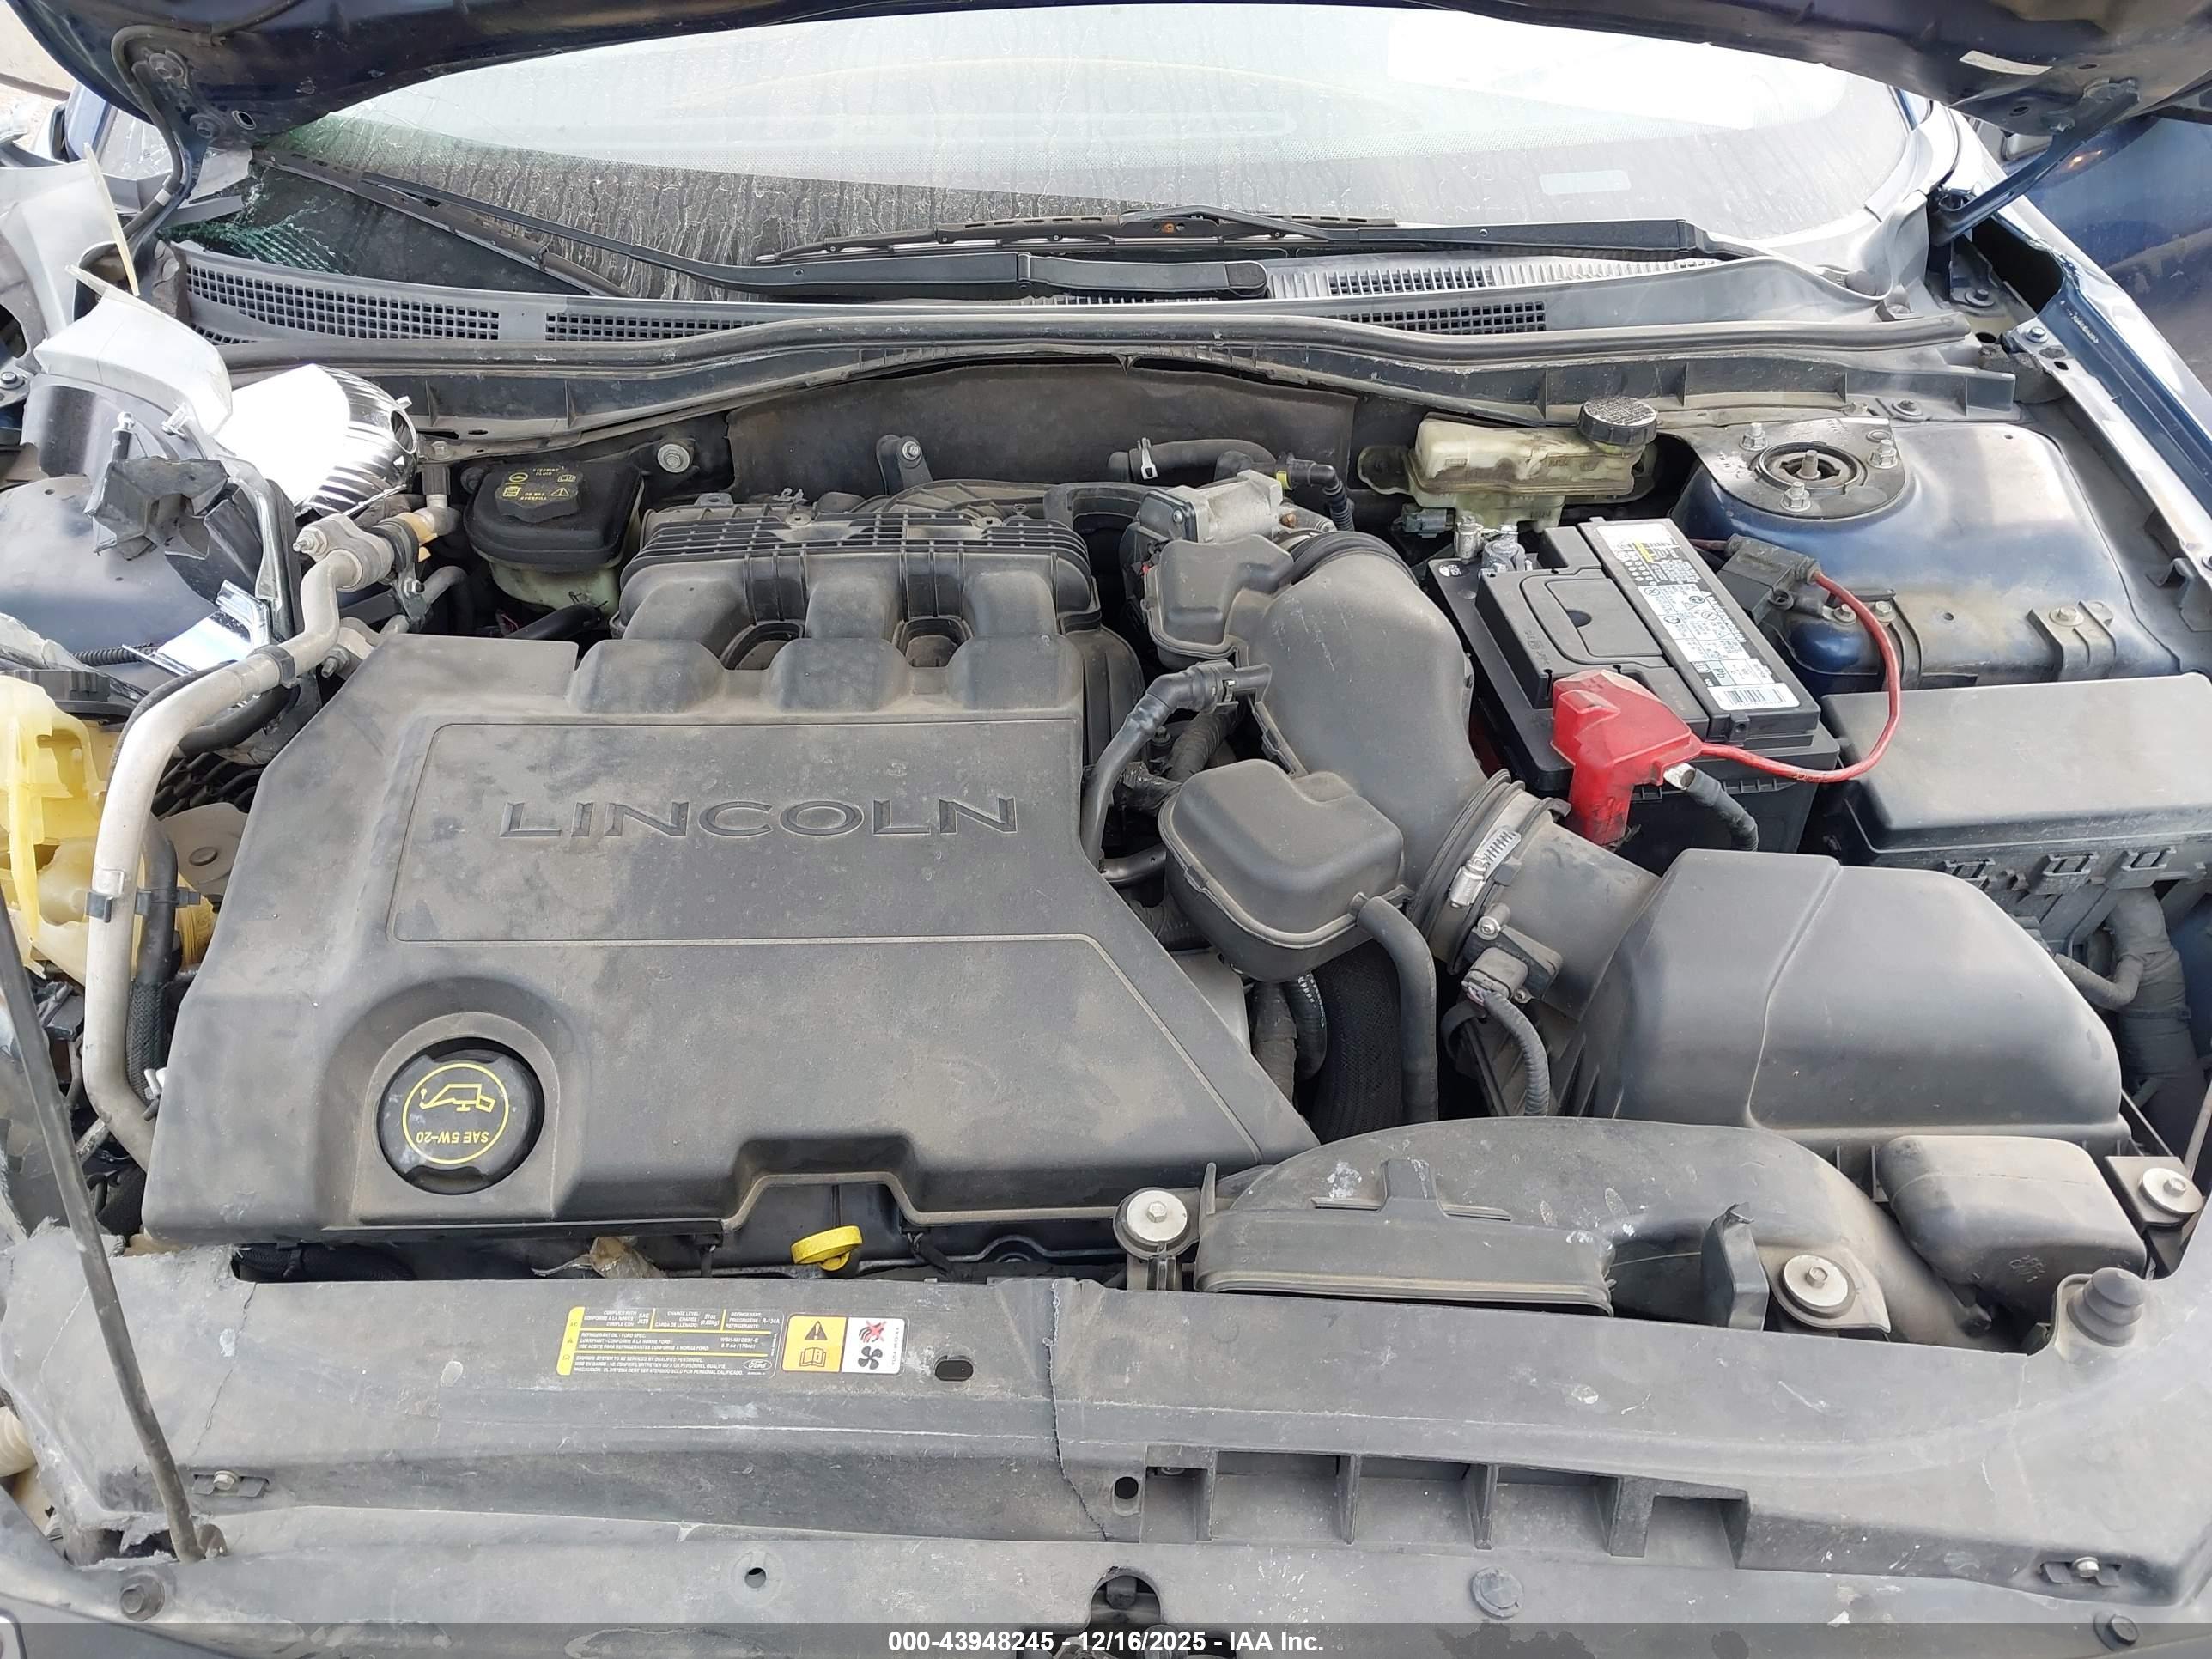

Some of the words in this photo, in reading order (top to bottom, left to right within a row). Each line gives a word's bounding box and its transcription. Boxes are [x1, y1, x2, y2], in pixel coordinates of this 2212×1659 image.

[1713, 667, 1726, 678] Pb
[499, 796, 1018, 839] LINCOLN
[416, 1131, 460, 1144] 5W-20
[464, 1130, 489, 1144] SAE
